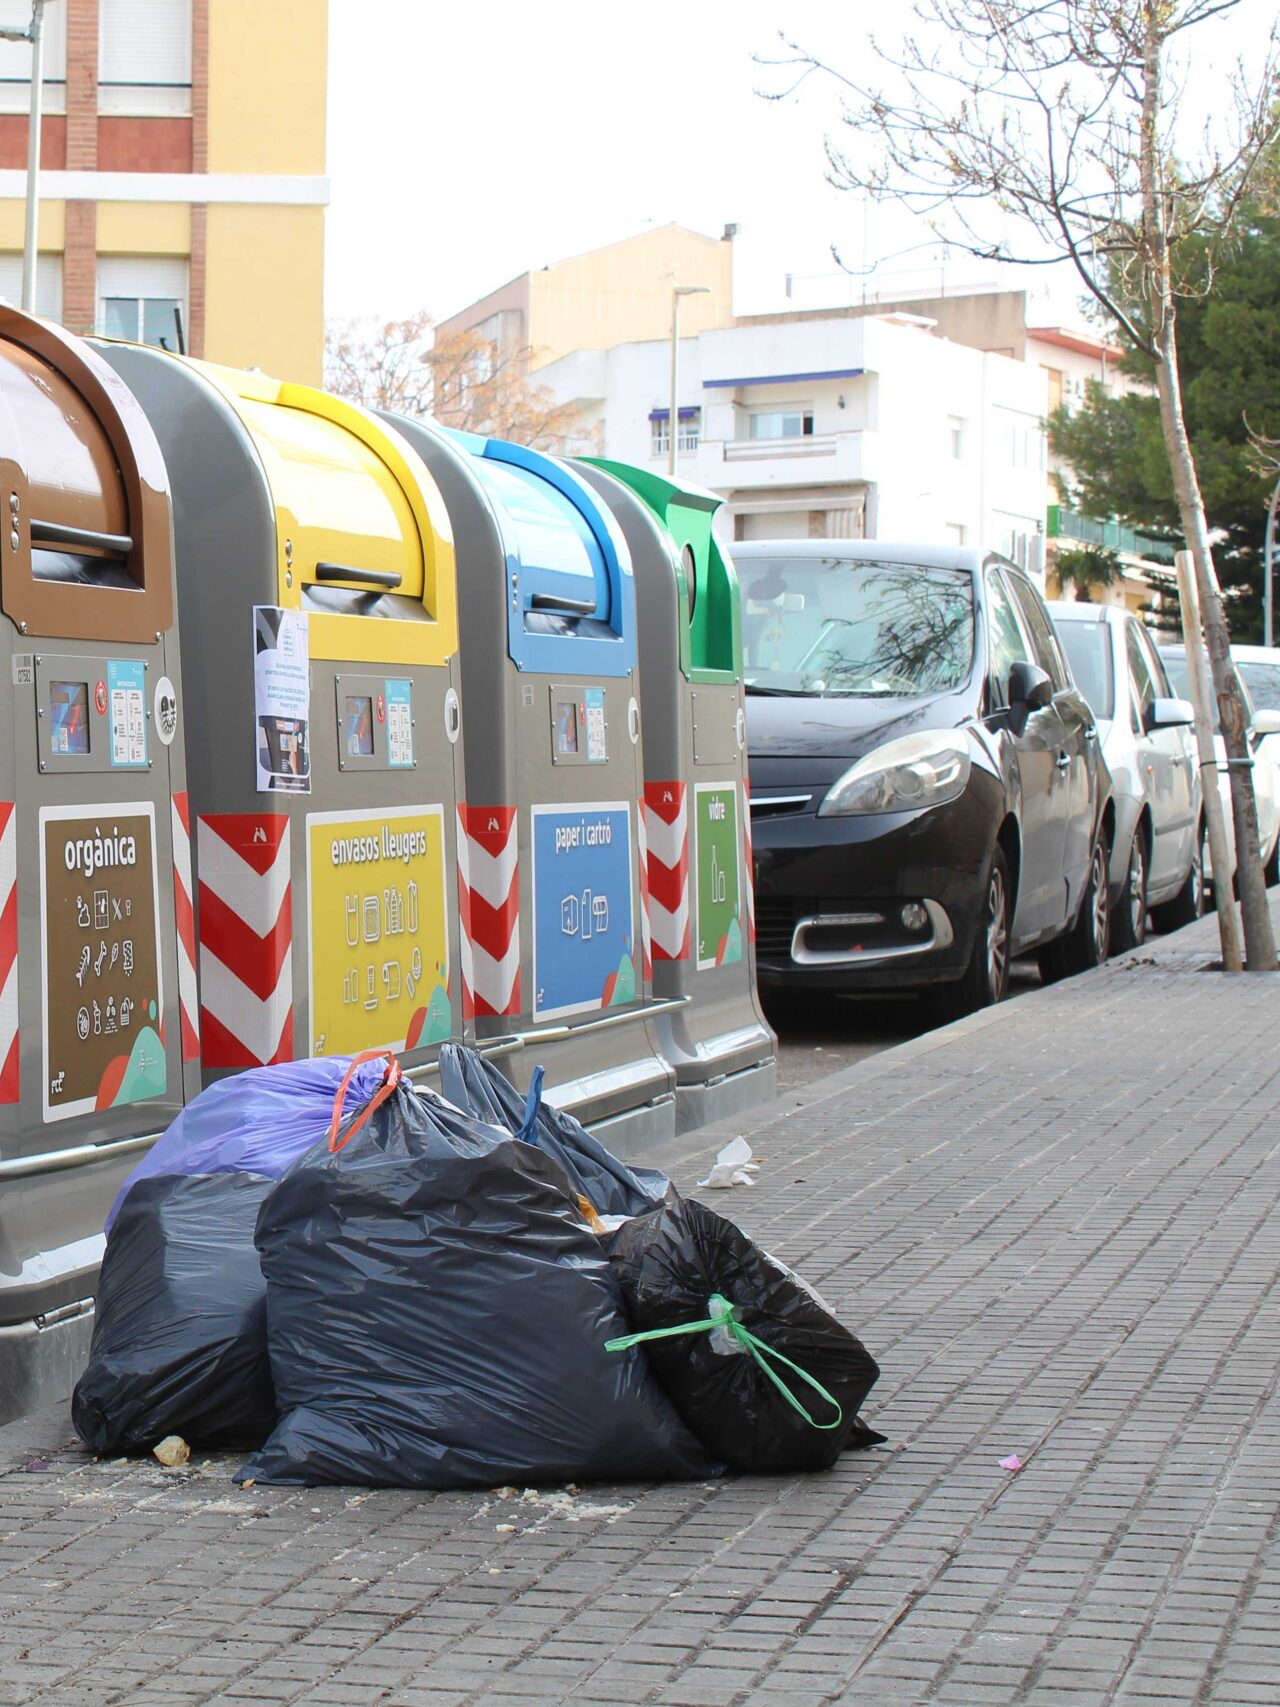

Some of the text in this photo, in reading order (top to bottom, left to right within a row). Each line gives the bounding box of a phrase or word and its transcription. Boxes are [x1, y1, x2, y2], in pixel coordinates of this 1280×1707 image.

[708, 795, 726, 821] vidre
[64, 825, 136, 878] orgànica
[331, 825, 426, 866] envasos lleugers
[555, 816, 612, 855] paper i cartró
